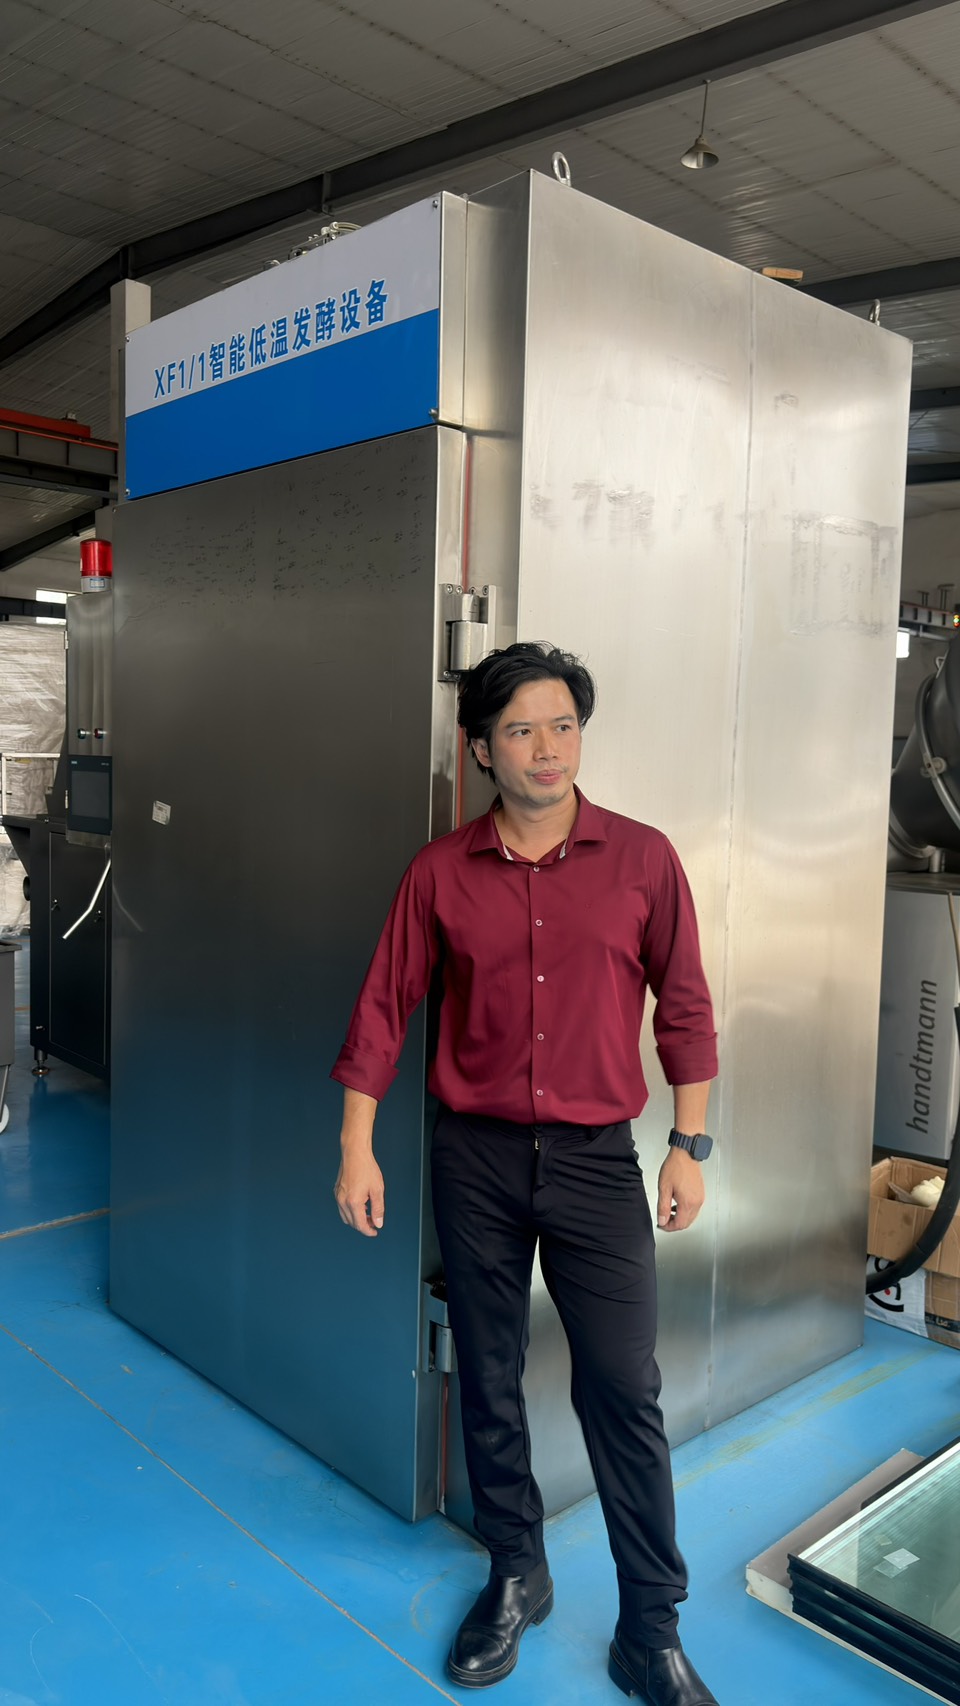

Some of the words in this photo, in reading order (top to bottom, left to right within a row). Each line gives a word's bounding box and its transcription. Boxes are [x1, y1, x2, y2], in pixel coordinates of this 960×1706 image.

[154, 279, 388, 399] XF1/1智能低温发酵设备
[905, 979, 938, 1134] handtmann
